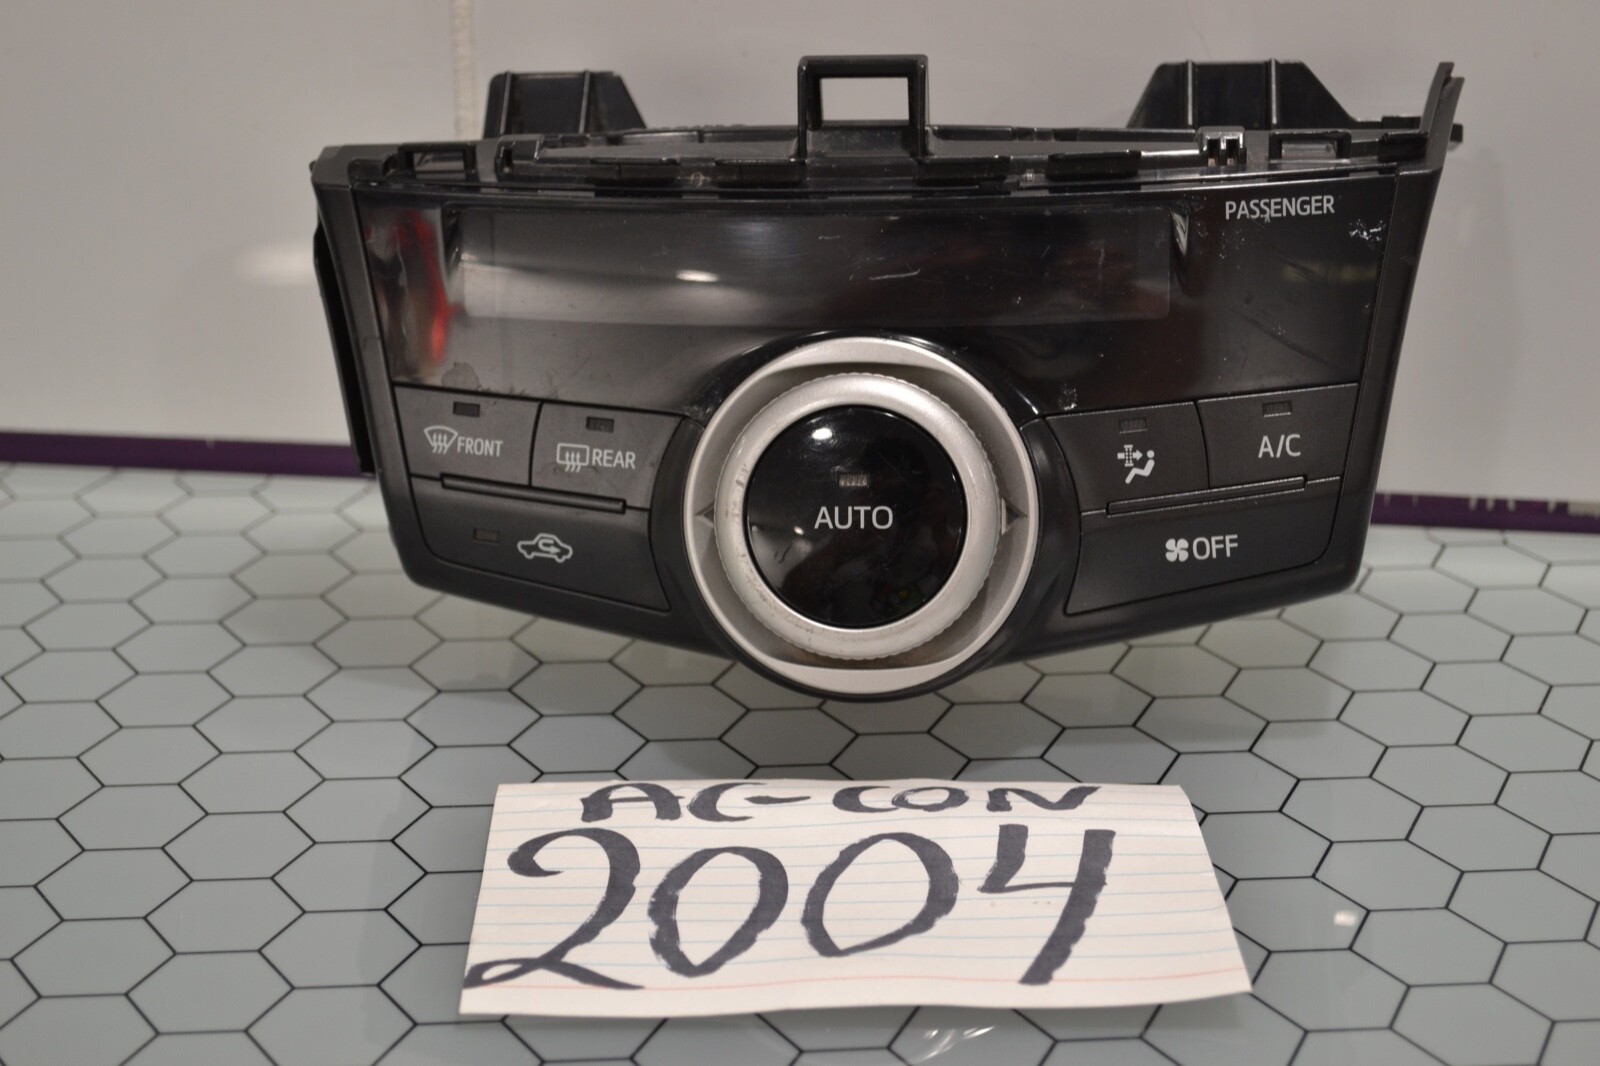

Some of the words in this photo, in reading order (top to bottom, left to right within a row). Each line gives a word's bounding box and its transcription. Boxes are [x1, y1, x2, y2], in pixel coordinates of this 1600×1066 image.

[1225, 195, 1335, 220] PASSENGER
[457, 436, 503, 458] FRONT
[1258, 433, 1302, 459] A/C
[591, 449, 636, 469] REAR
[814, 506, 894, 530] AUTO
[1192, 534, 1239, 560] OFF
[463, 824, 1117, 990] 2004
